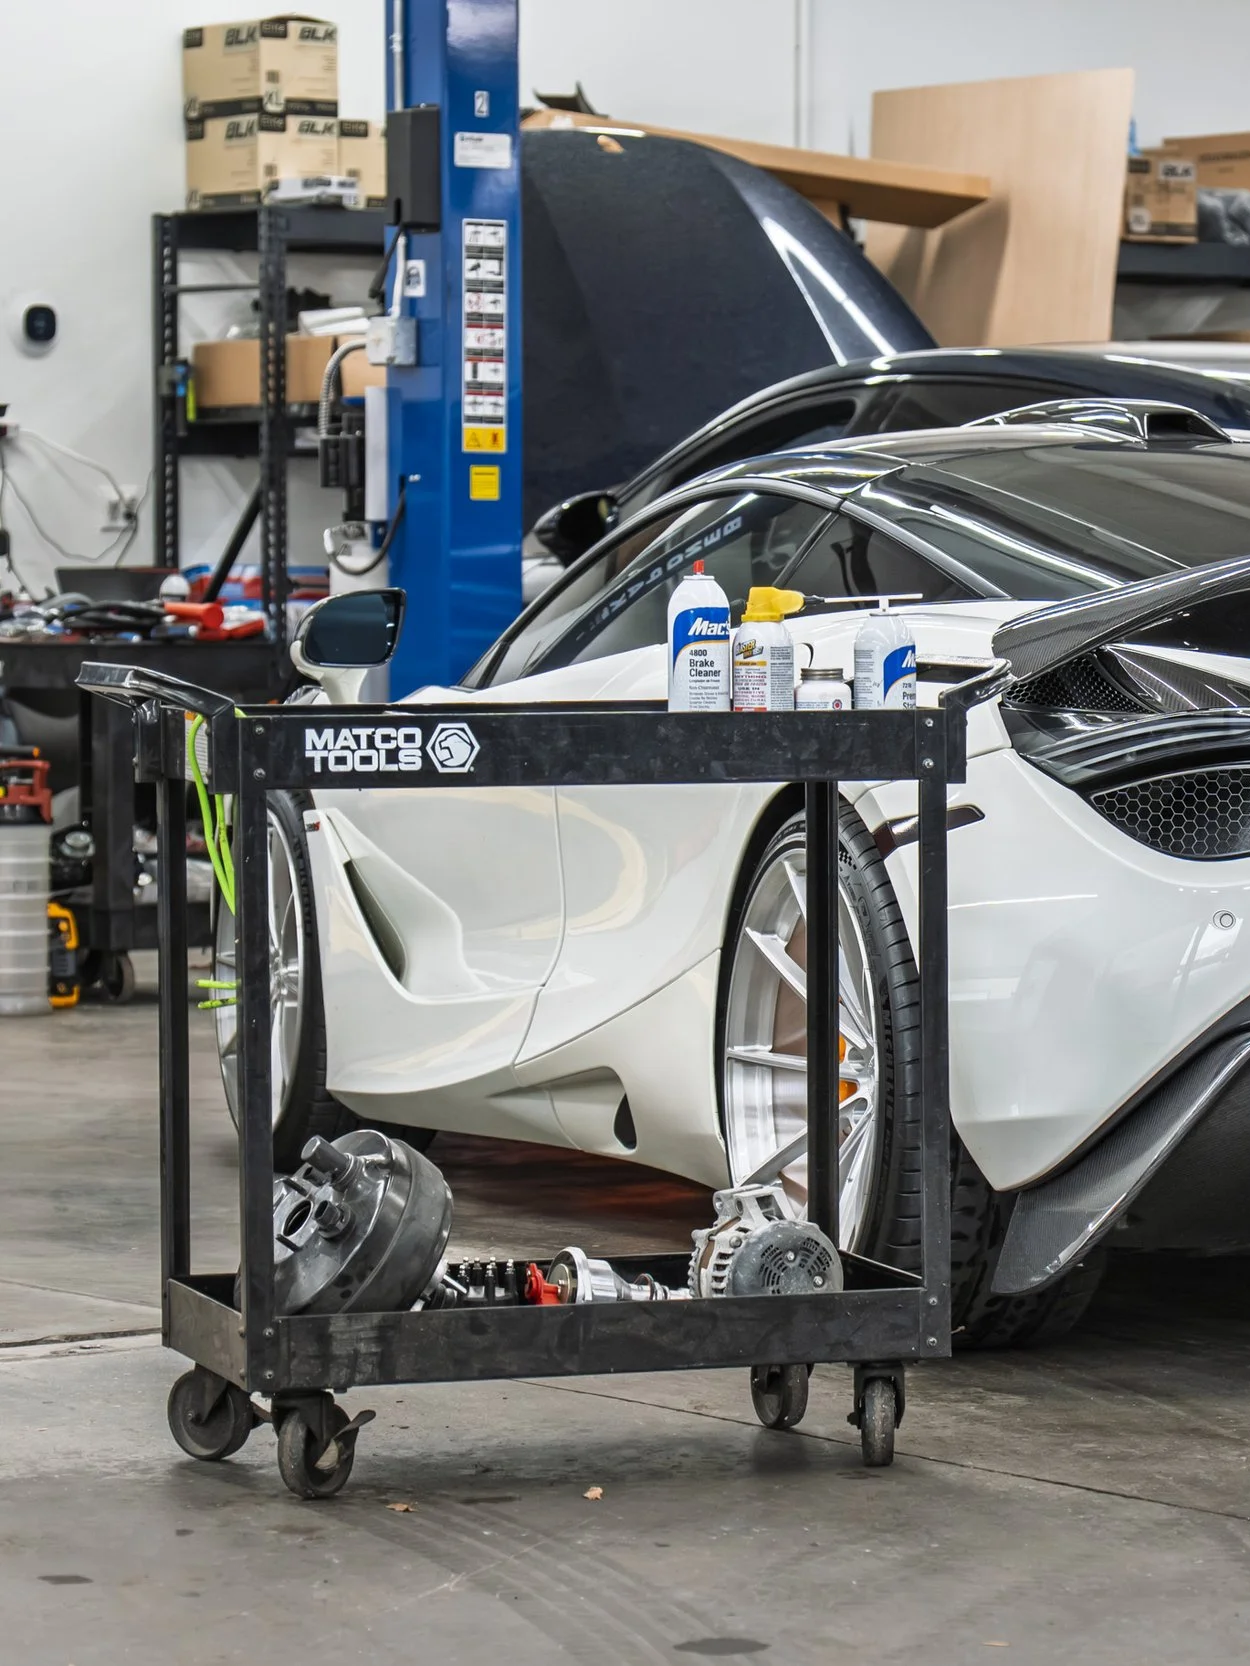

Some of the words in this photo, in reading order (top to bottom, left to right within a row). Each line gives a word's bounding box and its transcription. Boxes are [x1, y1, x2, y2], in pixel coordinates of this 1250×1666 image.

[225, 26, 257, 47] BLK
[298, 26, 336, 41] BLK
[689, 649, 708, 657] 4800
[689, 658, 715, 668] Brake
[689, 668, 721, 678] Cleaner
[305, 727, 422, 750] MATCO
[305, 749, 422, 773] TOOLS
